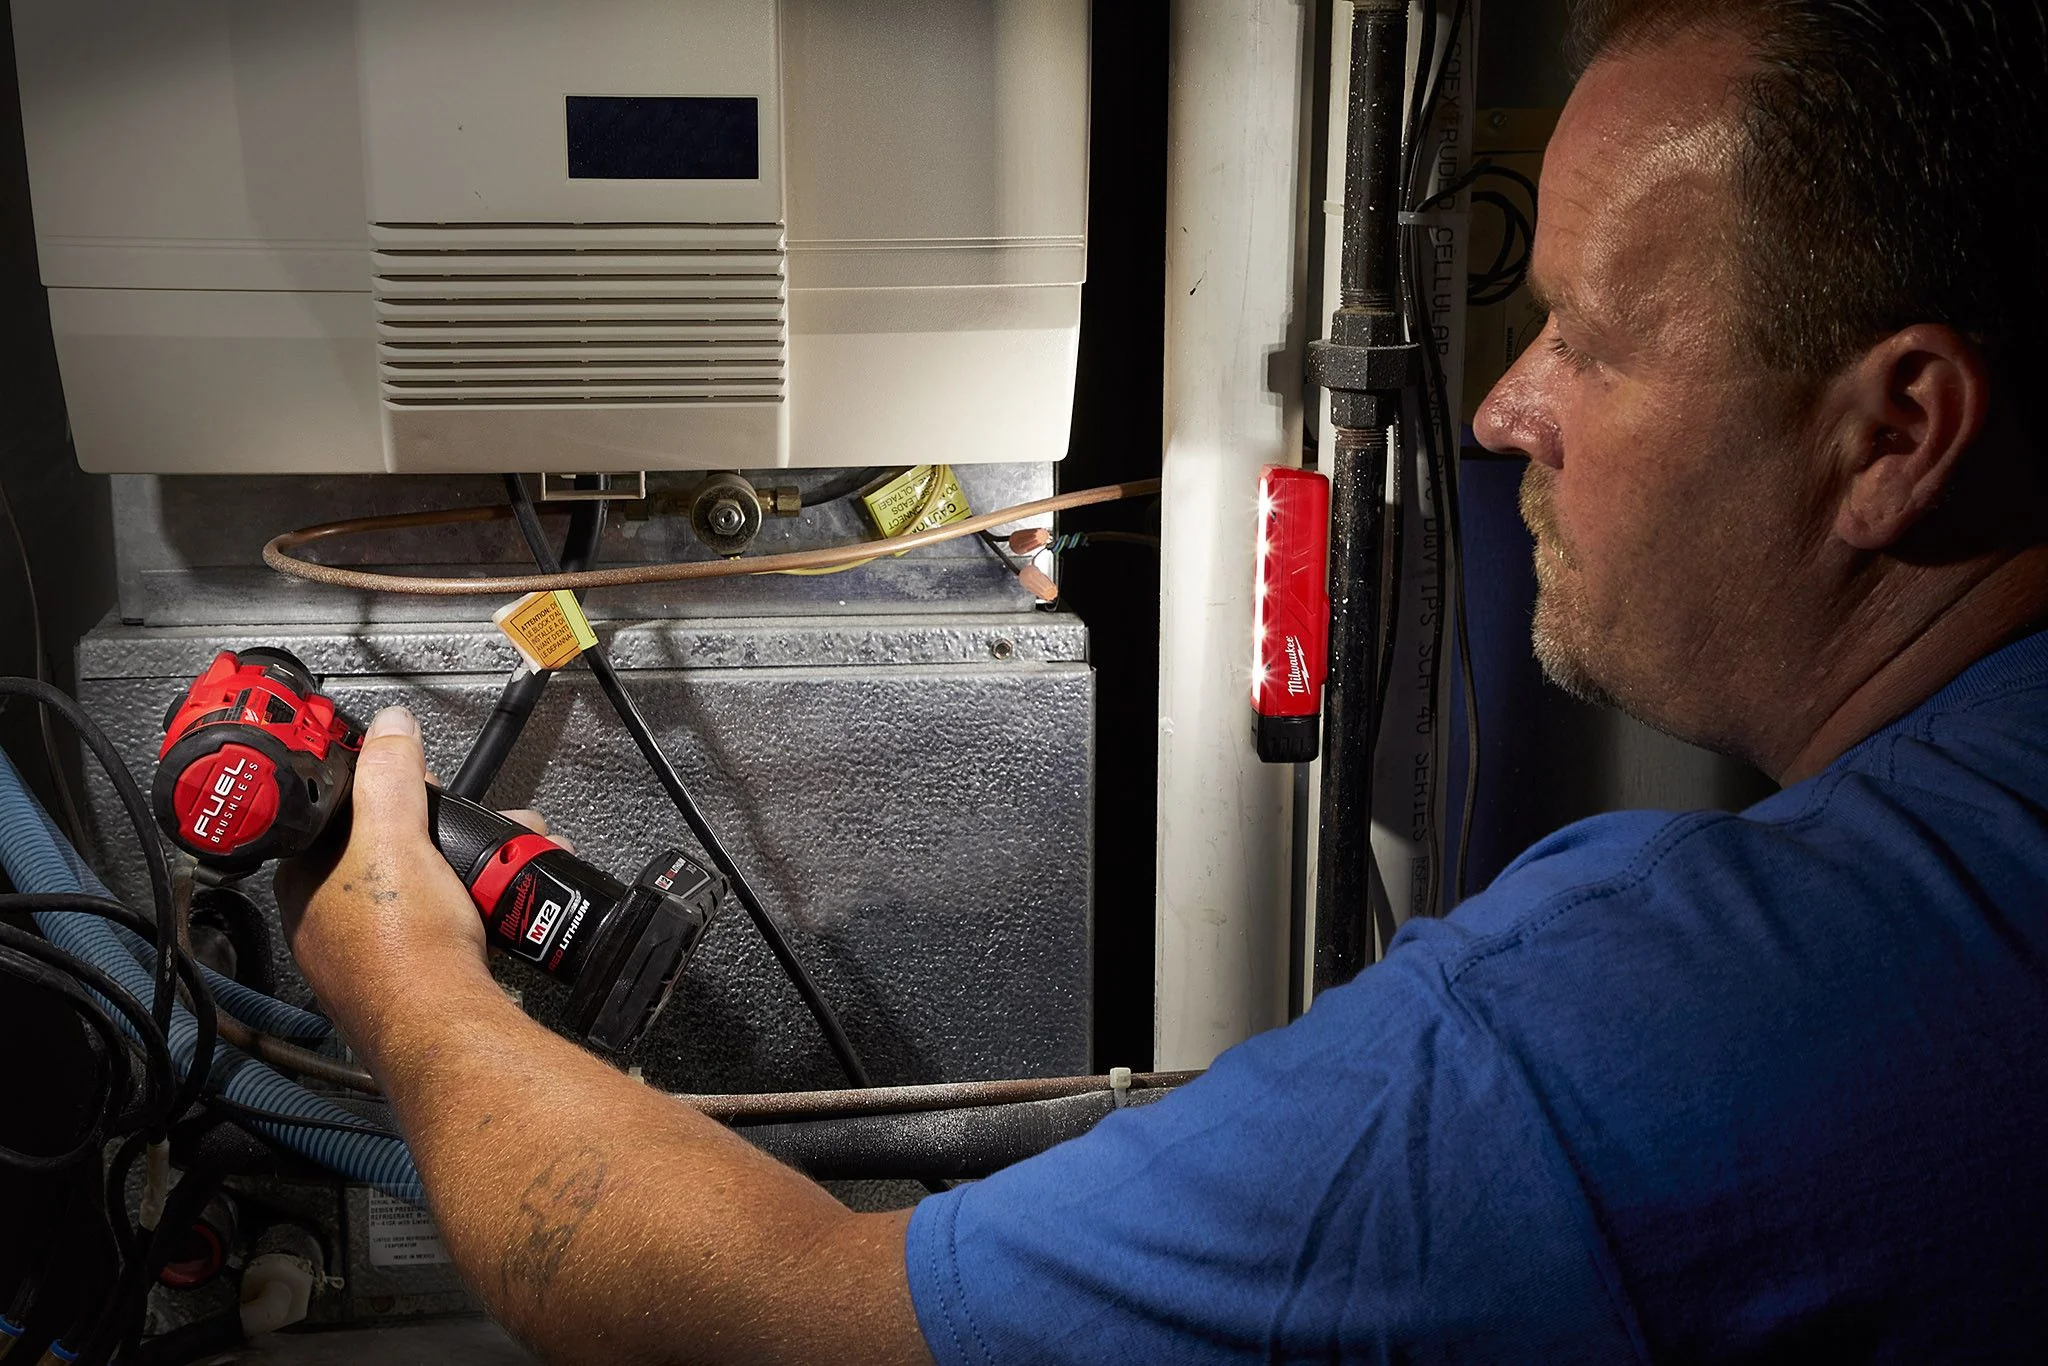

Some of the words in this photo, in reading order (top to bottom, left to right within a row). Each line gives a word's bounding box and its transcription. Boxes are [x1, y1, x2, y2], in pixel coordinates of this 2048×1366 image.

[892, 495, 919, 515] LEADS
[525, 630, 533, 638] LE
[532, 619, 549, 633] BLOCK
[1420, 585, 1440, 627] IPS
[536, 638, 552, 651] AVANT
[1285, 635, 1304, 697] Milwaukee
[193, 757, 246, 838] FUEL
[211, 762, 258, 843] BRUSHLESS
[1412, 752, 1430, 842] SERIES
[499, 872, 533, 941] Milwaukee
[529, 903, 558, 942] M12
